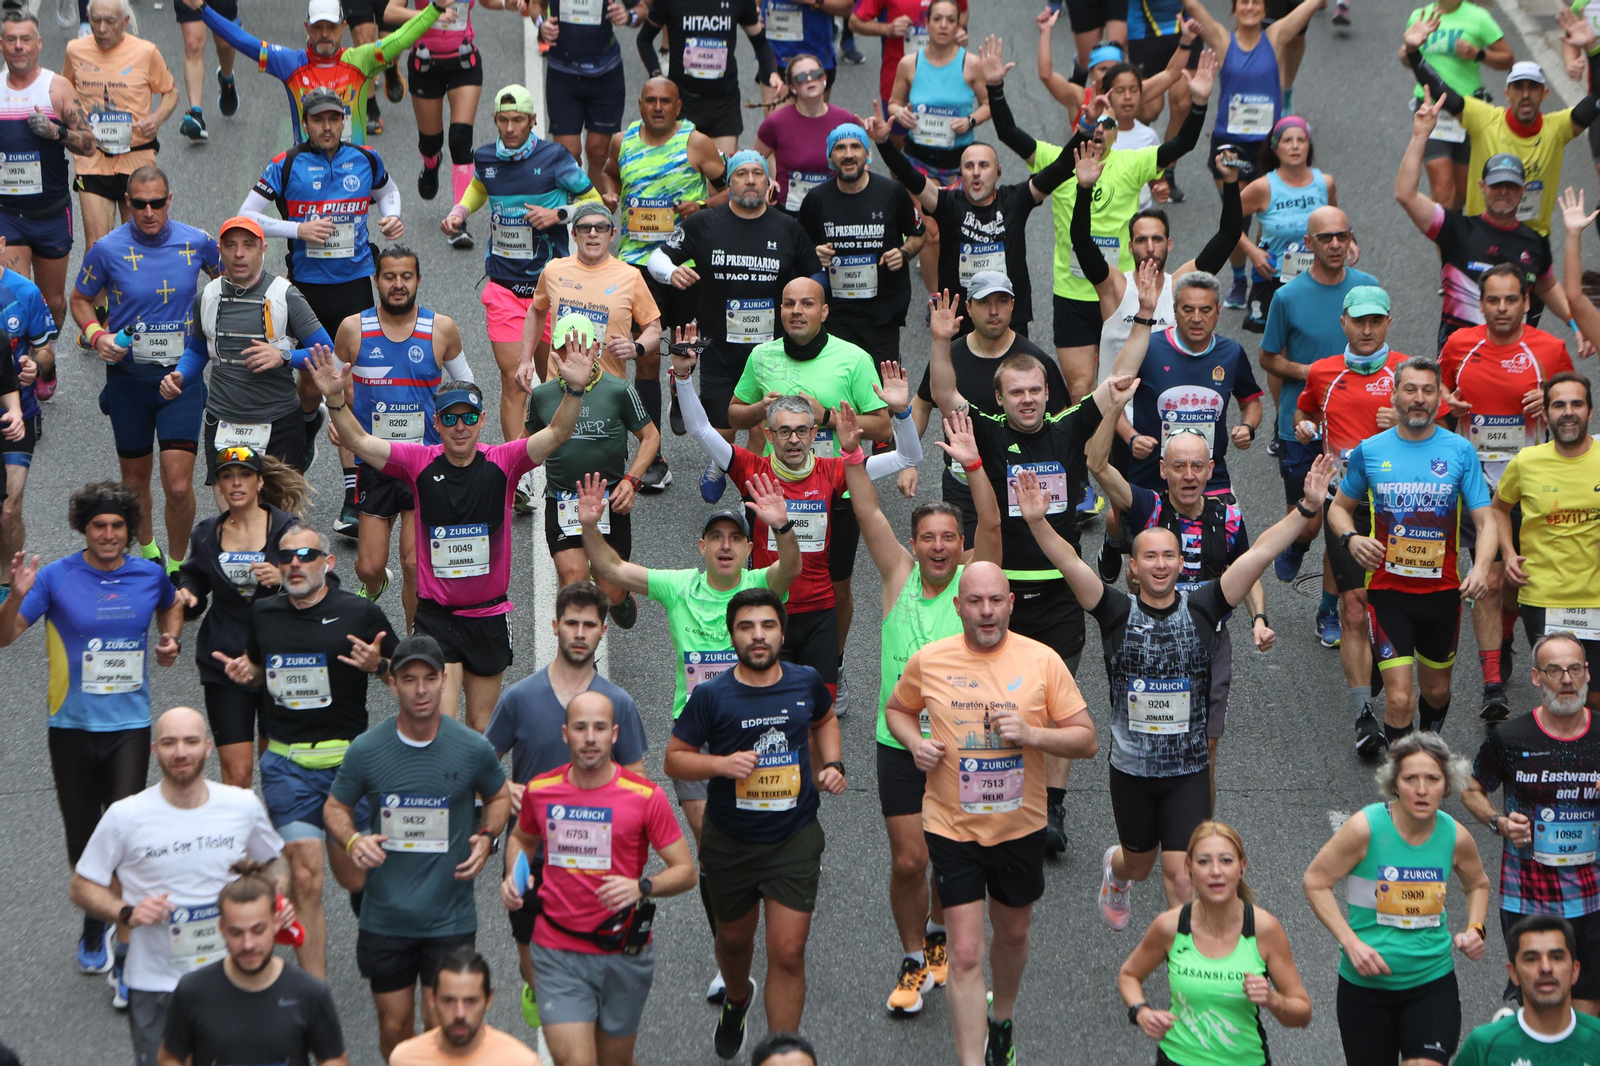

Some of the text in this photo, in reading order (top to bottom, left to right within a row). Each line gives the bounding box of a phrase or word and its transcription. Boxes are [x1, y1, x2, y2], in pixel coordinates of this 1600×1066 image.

[683, 16, 731, 31] HITACHI
[700, 39, 723, 47] ZURICH
[928, 107, 954, 115] ZURICH
[102, 114, 127, 122] ZURICH
[323, 200, 367, 213] PUEBLA
[641, 199, 668, 207] ZURICH
[1276, 195, 1316, 211] nerja
[641, 213, 656, 221] 5621
[835, 223, 885, 237] PRESIDIARIOS
[863, 240, 883, 248] IBÓN
[974, 244, 999, 254] ZURICH
[711, 254, 780, 270] LOS PRESIDIARIOS
[844, 255, 870, 265] ZURICH
[973, 259, 989, 268] 8527
[758, 273, 778, 281] IBÓN
[844, 271, 861, 279] 9657
[742, 315, 760, 323] 8528
[389, 403, 419, 411] ZURICH
[1180, 413, 1213, 422] ZURICH
[1488, 417, 1520, 425] ZURICH
[389, 419, 408, 427] 8202
[235, 428, 253, 436] 8677
[1487, 432, 1507, 441] 8474
[1026, 464, 1060, 473] ZURICH
[1377, 482, 1452, 495] INFORMALES
[790, 503, 822, 511] ZURICH
[449, 527, 482, 535] ZURICH
[1409, 529, 1440, 538] ZURICH
[447, 544, 473, 553] 10049
[1406, 546, 1426, 555] 4374
[232, 554, 265, 562] ZURICH
[1405, 557, 1418, 565] DEL
[1419, 559, 1435, 567] TACO
[1563, 619, 1588, 627] BURGOS
[105, 641, 139, 649] ZURICH
[285, 656, 321, 666] ZURICH
[1149, 681, 1183, 691] ZURICH
[1148, 700, 1170, 709] 9204
[1144, 714, 1174, 722] JONATAN
[742, 719, 762, 729] EDP
[759, 754, 792, 765] ZURICH
[982, 759, 1017, 770] ZURICH
[758, 775, 780, 784] 4177
[1516, 770, 1600, 782] Run Eastwards
[982, 779, 1004, 788] 7513
[746, 789, 792, 798] RUI TEIXEIRA
[1556, 787, 1581, 799] and
[403, 797, 441, 807] ZURICH
[569, 809, 605, 820] ZURICH
[1559, 811, 1595, 820] ZURICH
[403, 816, 426, 825] 9432
[566, 830, 588, 840] 6753
[1555, 830, 1582, 839] 10952
[1558, 845, 1578, 853] SLAP
[1403, 870, 1437, 880] ZURICH
[1401, 890, 1424, 900] 5909
